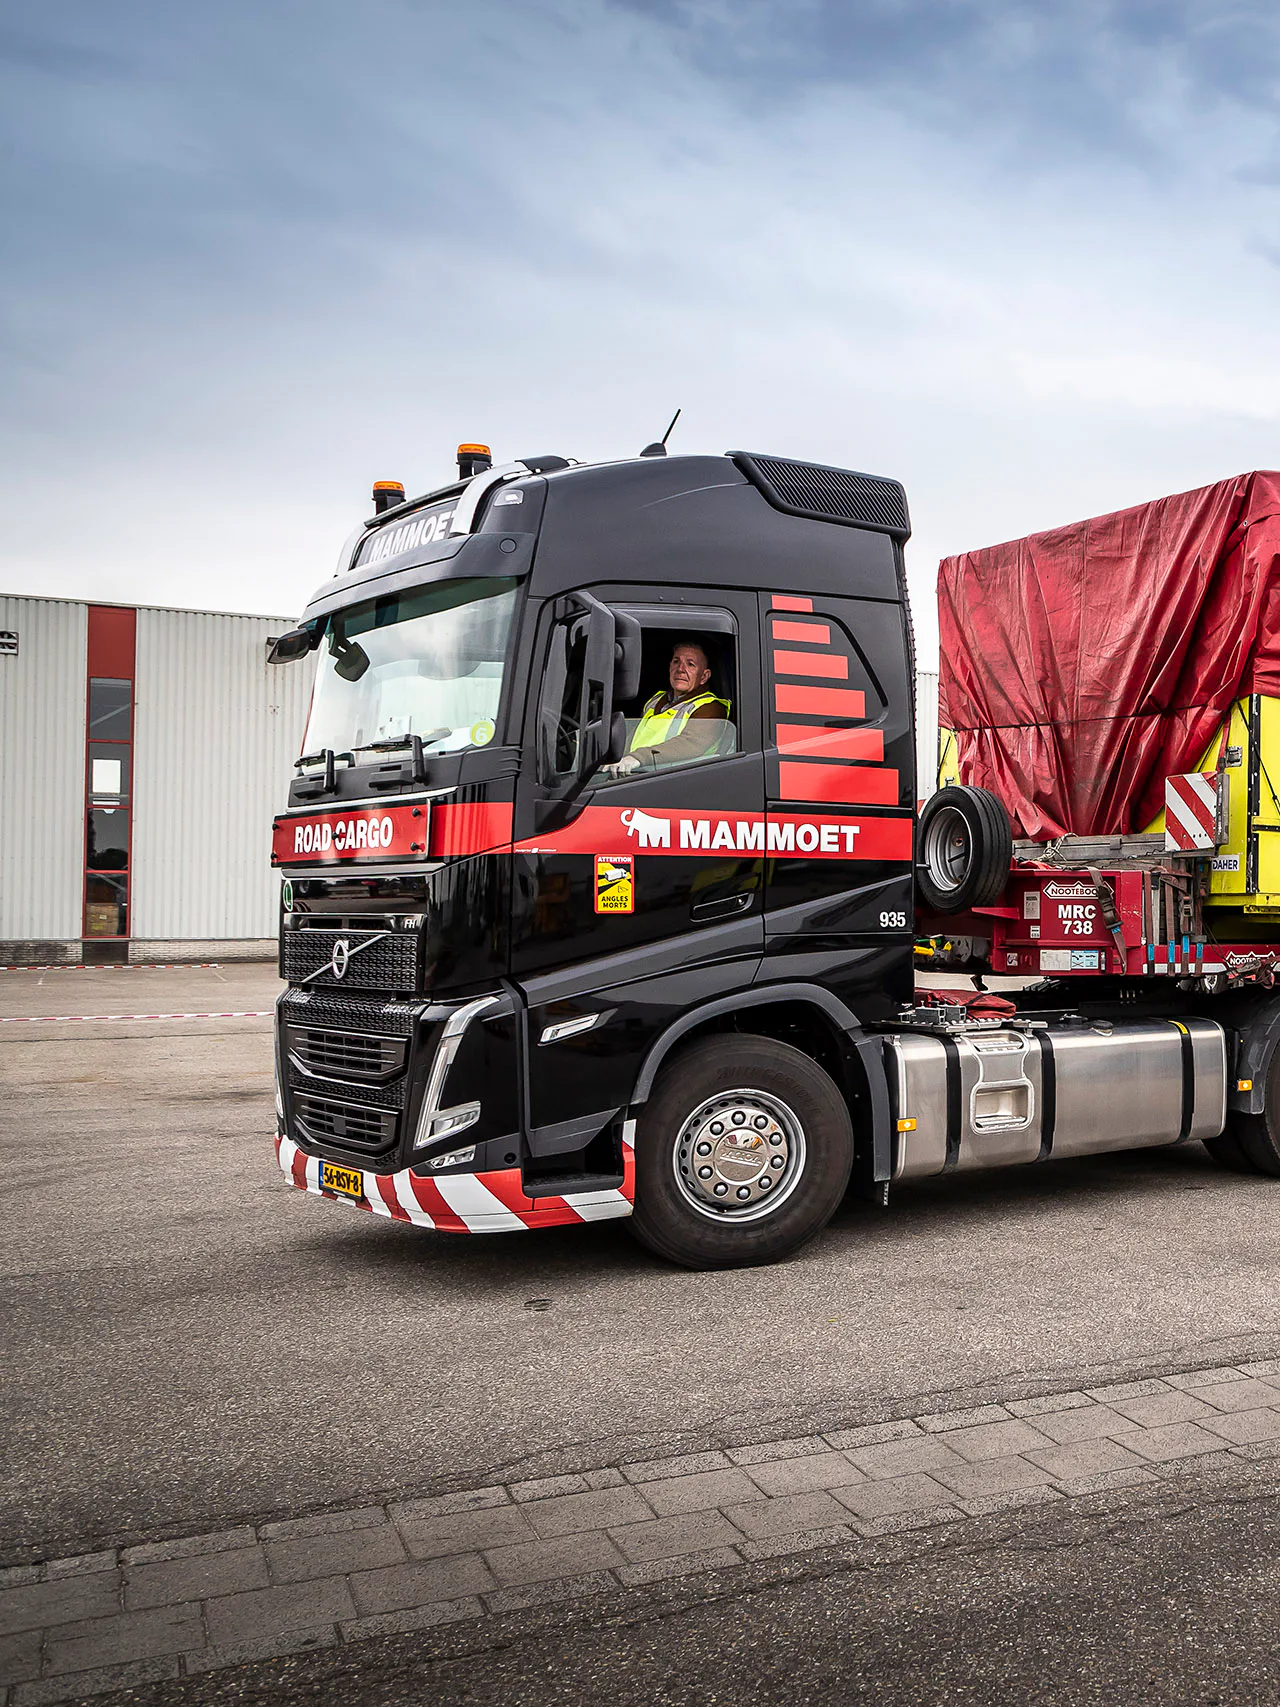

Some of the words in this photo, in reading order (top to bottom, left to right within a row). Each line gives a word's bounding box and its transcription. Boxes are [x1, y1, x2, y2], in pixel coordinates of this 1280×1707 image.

[369, 511, 455, 563] MAMMOE
[294, 823, 332, 854] ROAD
[335, 816, 394, 851] CARGO
[680, 819, 860, 853] MAMMOET
[1212, 859, 1238, 870] DAHER
[879, 911, 906, 927] 935
[1058, 904, 1097, 919] MRC
[404, 919, 416, 929] FH
[1062, 920, 1093, 935] 738
[1230, 957, 1260, 965] NOOTE
